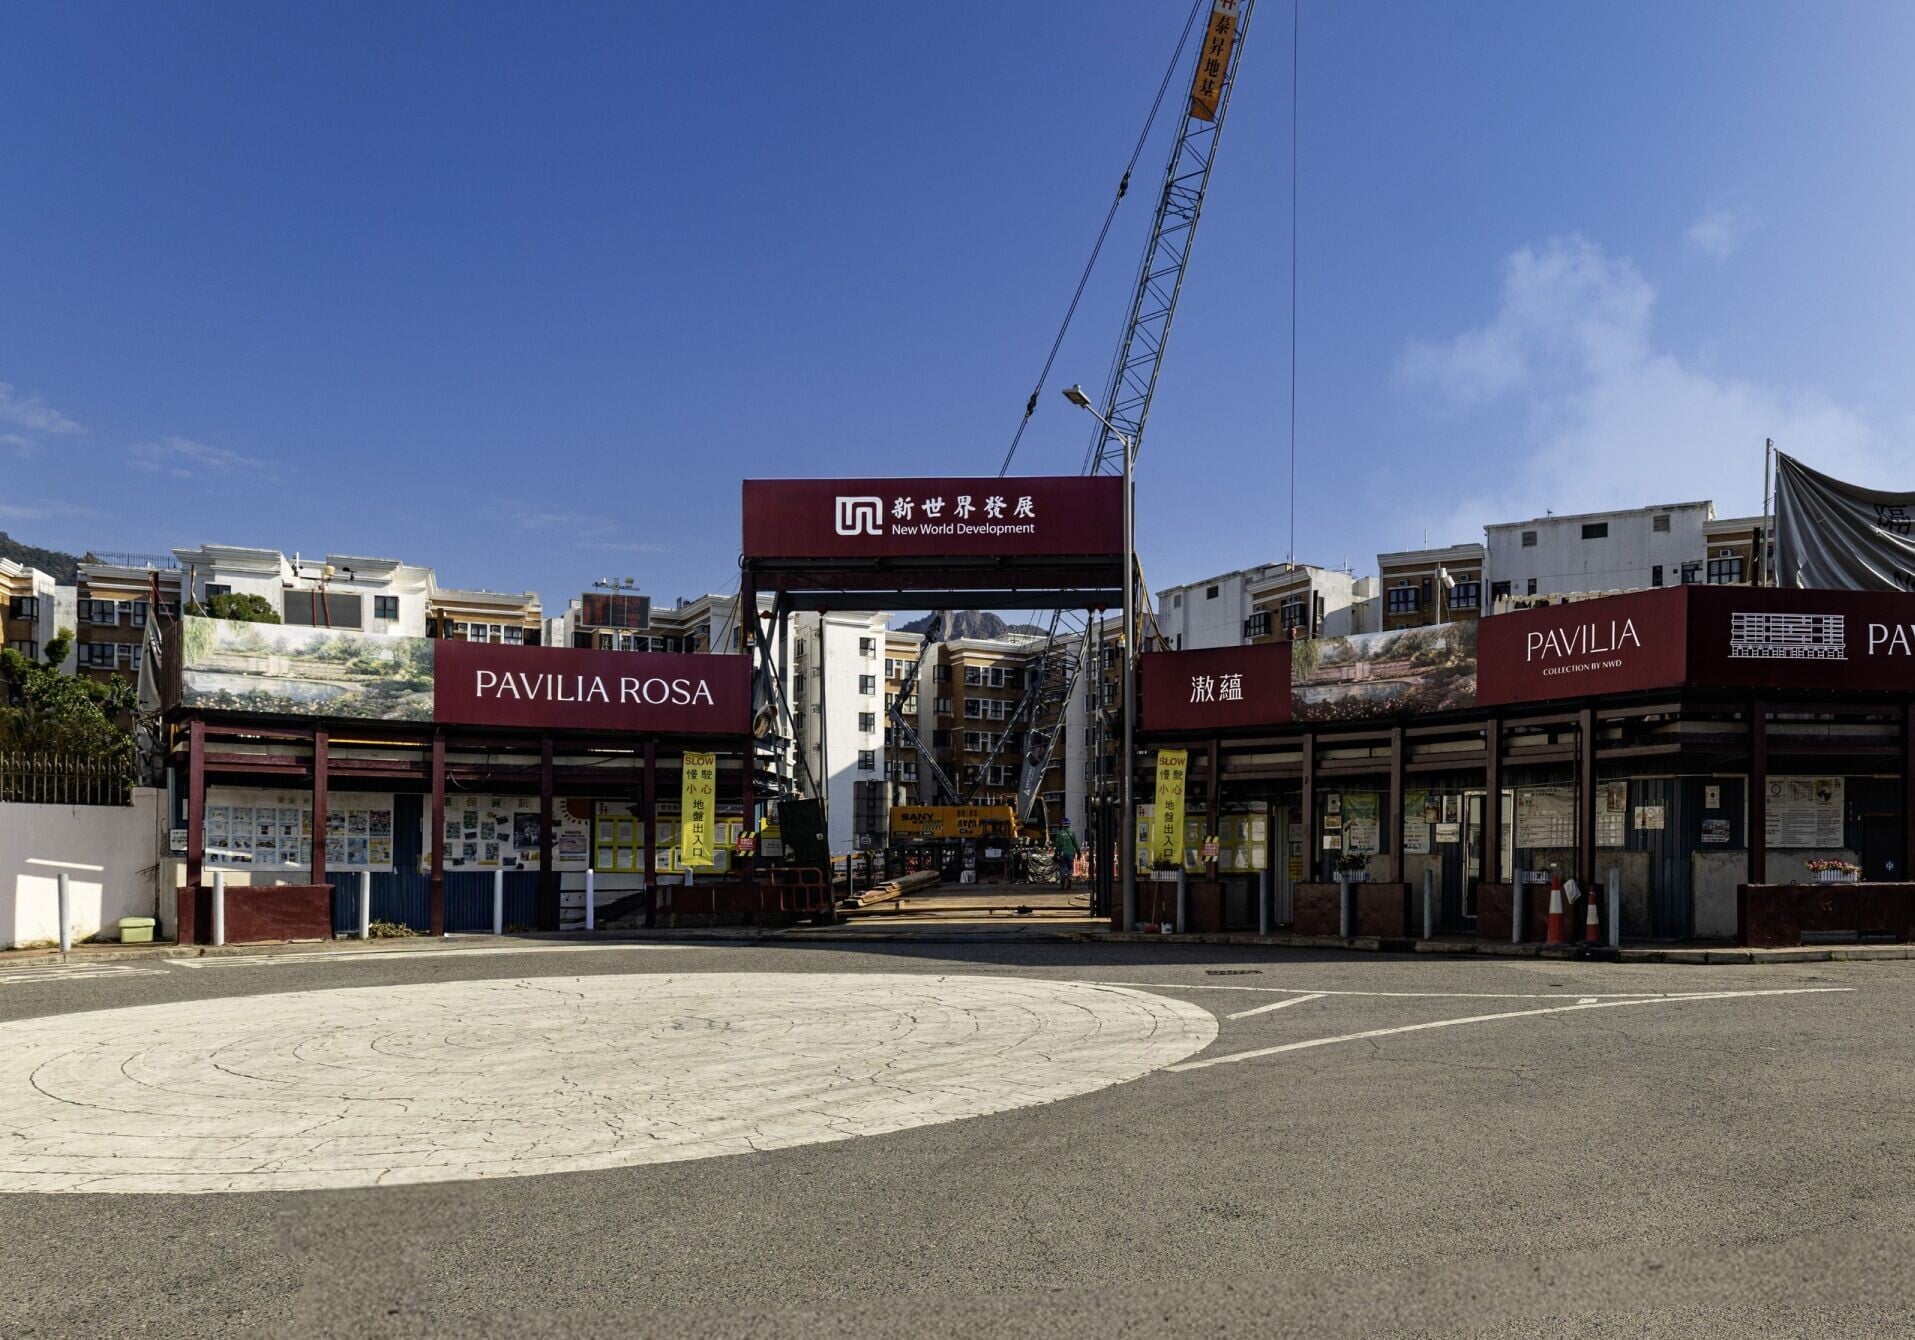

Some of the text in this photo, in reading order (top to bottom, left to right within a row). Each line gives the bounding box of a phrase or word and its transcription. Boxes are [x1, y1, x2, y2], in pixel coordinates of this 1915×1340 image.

[1200, 15, 1230, 98] 泰昇地基
[891, 495, 1036, 520] 新世界發展
[892, 523, 1035, 536] New World Development
[1526, 617, 1641, 662] PAVILIA
[1868, 623, 1915, 656] PA
[1542, 659, 1622, 676] COLLECTION BY NWD
[476, 670, 714, 705] PAVILIA ROSA
[685, 756, 714, 766] SLOW
[1159, 757, 1185, 766] SLOW
[686, 769, 713, 780] 慢駛
[686, 783, 712, 795] 小心
[1158, 783, 1183, 796] 小心
[901, 812, 934, 821] SANY
[692, 799, 705, 857] 地盤出入口
[1163, 800, 1175, 858] 地盤出入口
